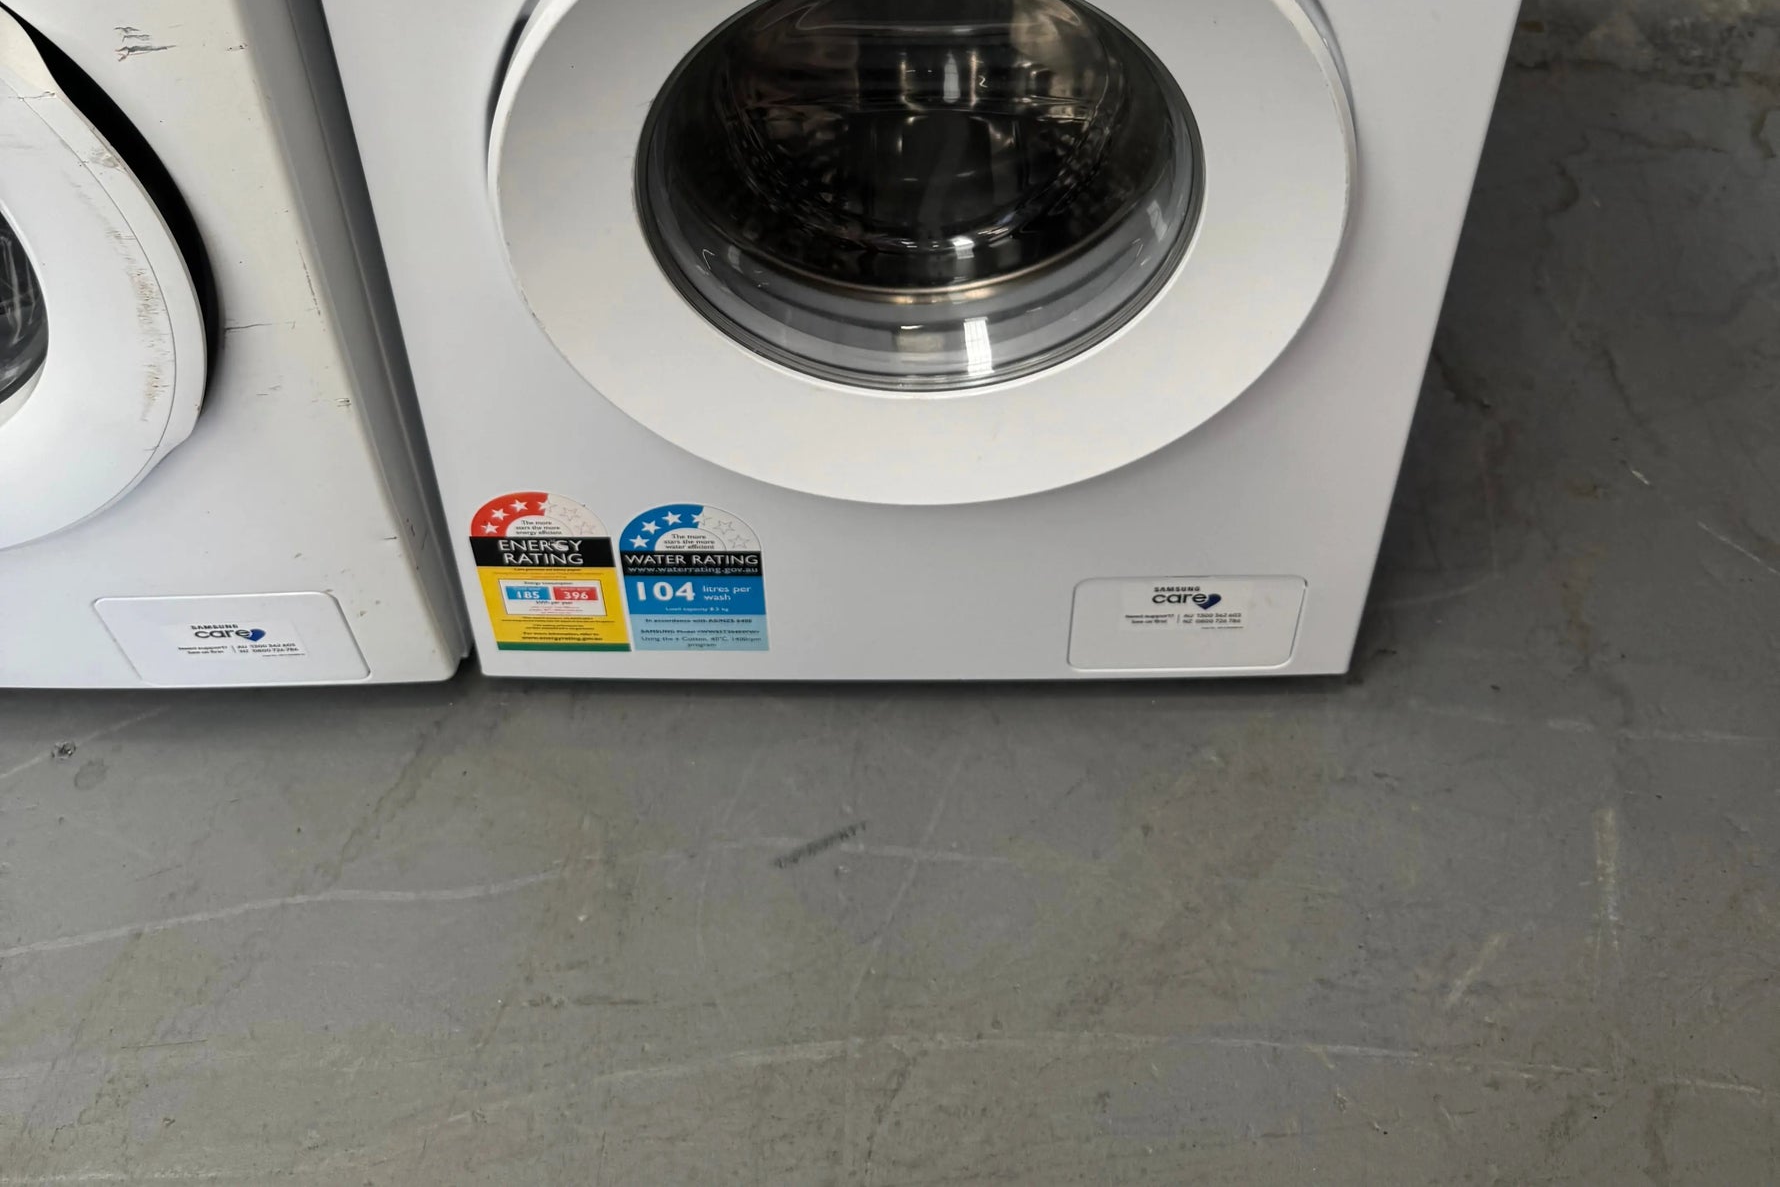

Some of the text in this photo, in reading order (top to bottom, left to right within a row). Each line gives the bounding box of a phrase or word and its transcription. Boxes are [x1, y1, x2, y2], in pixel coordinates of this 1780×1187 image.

[499, 540, 583, 552] ENERGY
[504, 554, 584, 565] RATING
[625, 555, 758, 565] WATER RATING
[628, 566, 758, 574] www.waterrating.gov.au
[516, 591, 540, 599] 185
[563, 591, 589, 599] 396
[637, 582, 695, 601] 104
[1152, 594, 1207, 604] care
[195, 629, 250, 638] care
